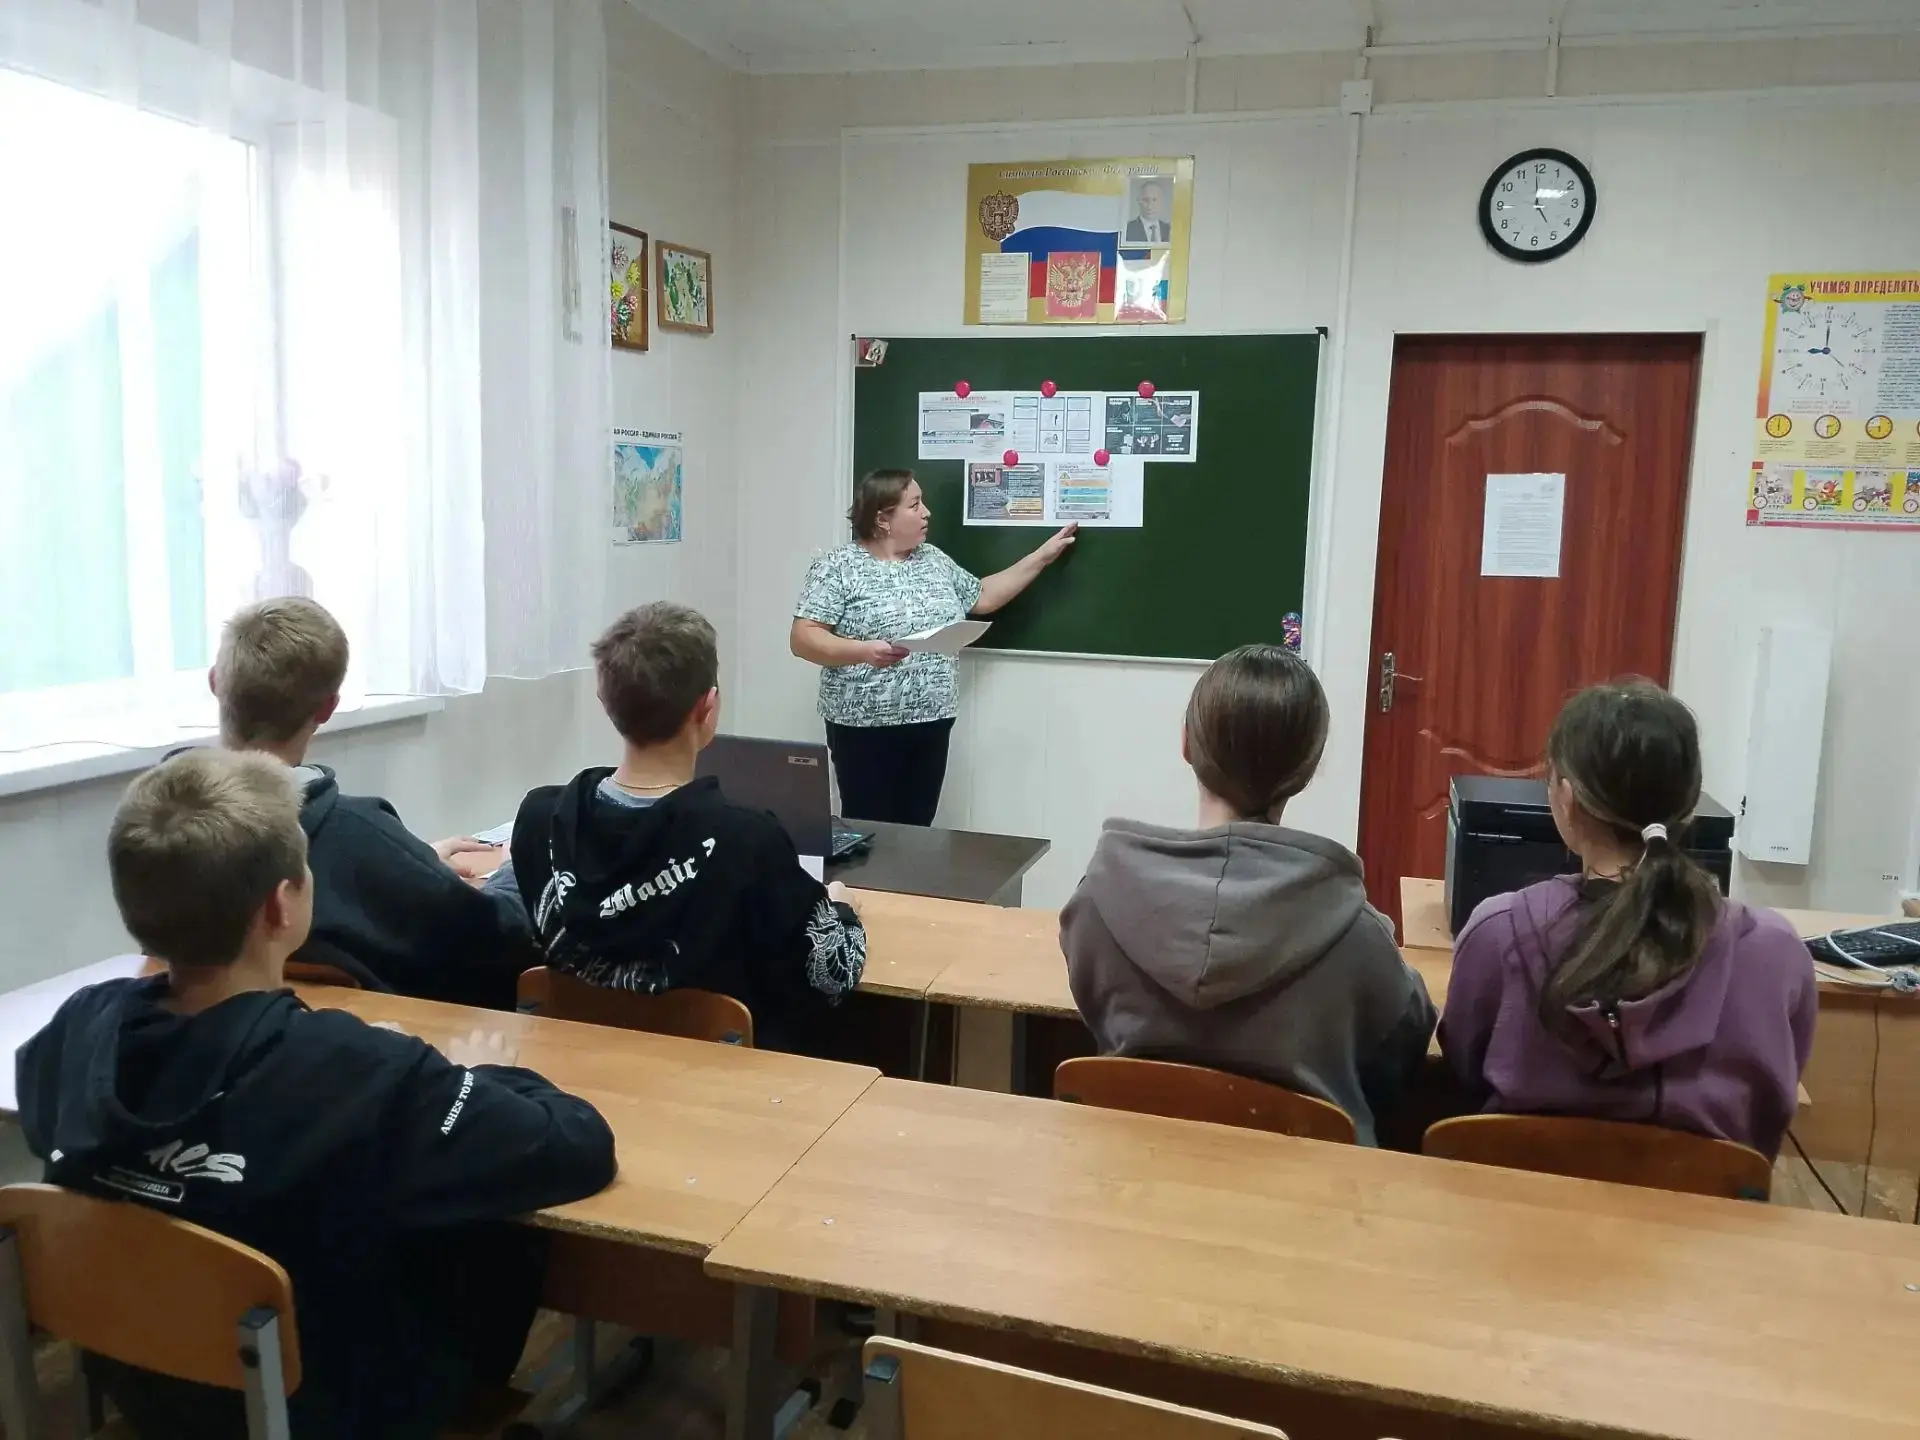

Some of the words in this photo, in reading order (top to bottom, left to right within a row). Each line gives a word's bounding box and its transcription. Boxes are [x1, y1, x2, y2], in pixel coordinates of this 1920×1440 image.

[1534, 164, 1546, 174] 12
[1555, 168, 1560, 178] 1
[1517, 170, 1526, 180] 11
[1501, 182, 1513, 192] 10
[1567, 180, 1575, 190] 2
[1497, 201, 1504, 211] 9
[1571, 198, 1579, 208] 3
[1501, 219, 1508, 229] 8
[1564, 218, 1571, 227] 4
[1513, 232, 1520, 241] 7
[1550, 231, 1557, 240] 5
[1531, 236, 1538, 246] 6
[1810, 280, 1850, 294] УЧИМСЯ
[1854, 280, 1920, 295] ОПРЕДЕЛЯТЬ
[441, 1100, 464, 1136] ASHES
[459, 1086, 471, 1099] TO
